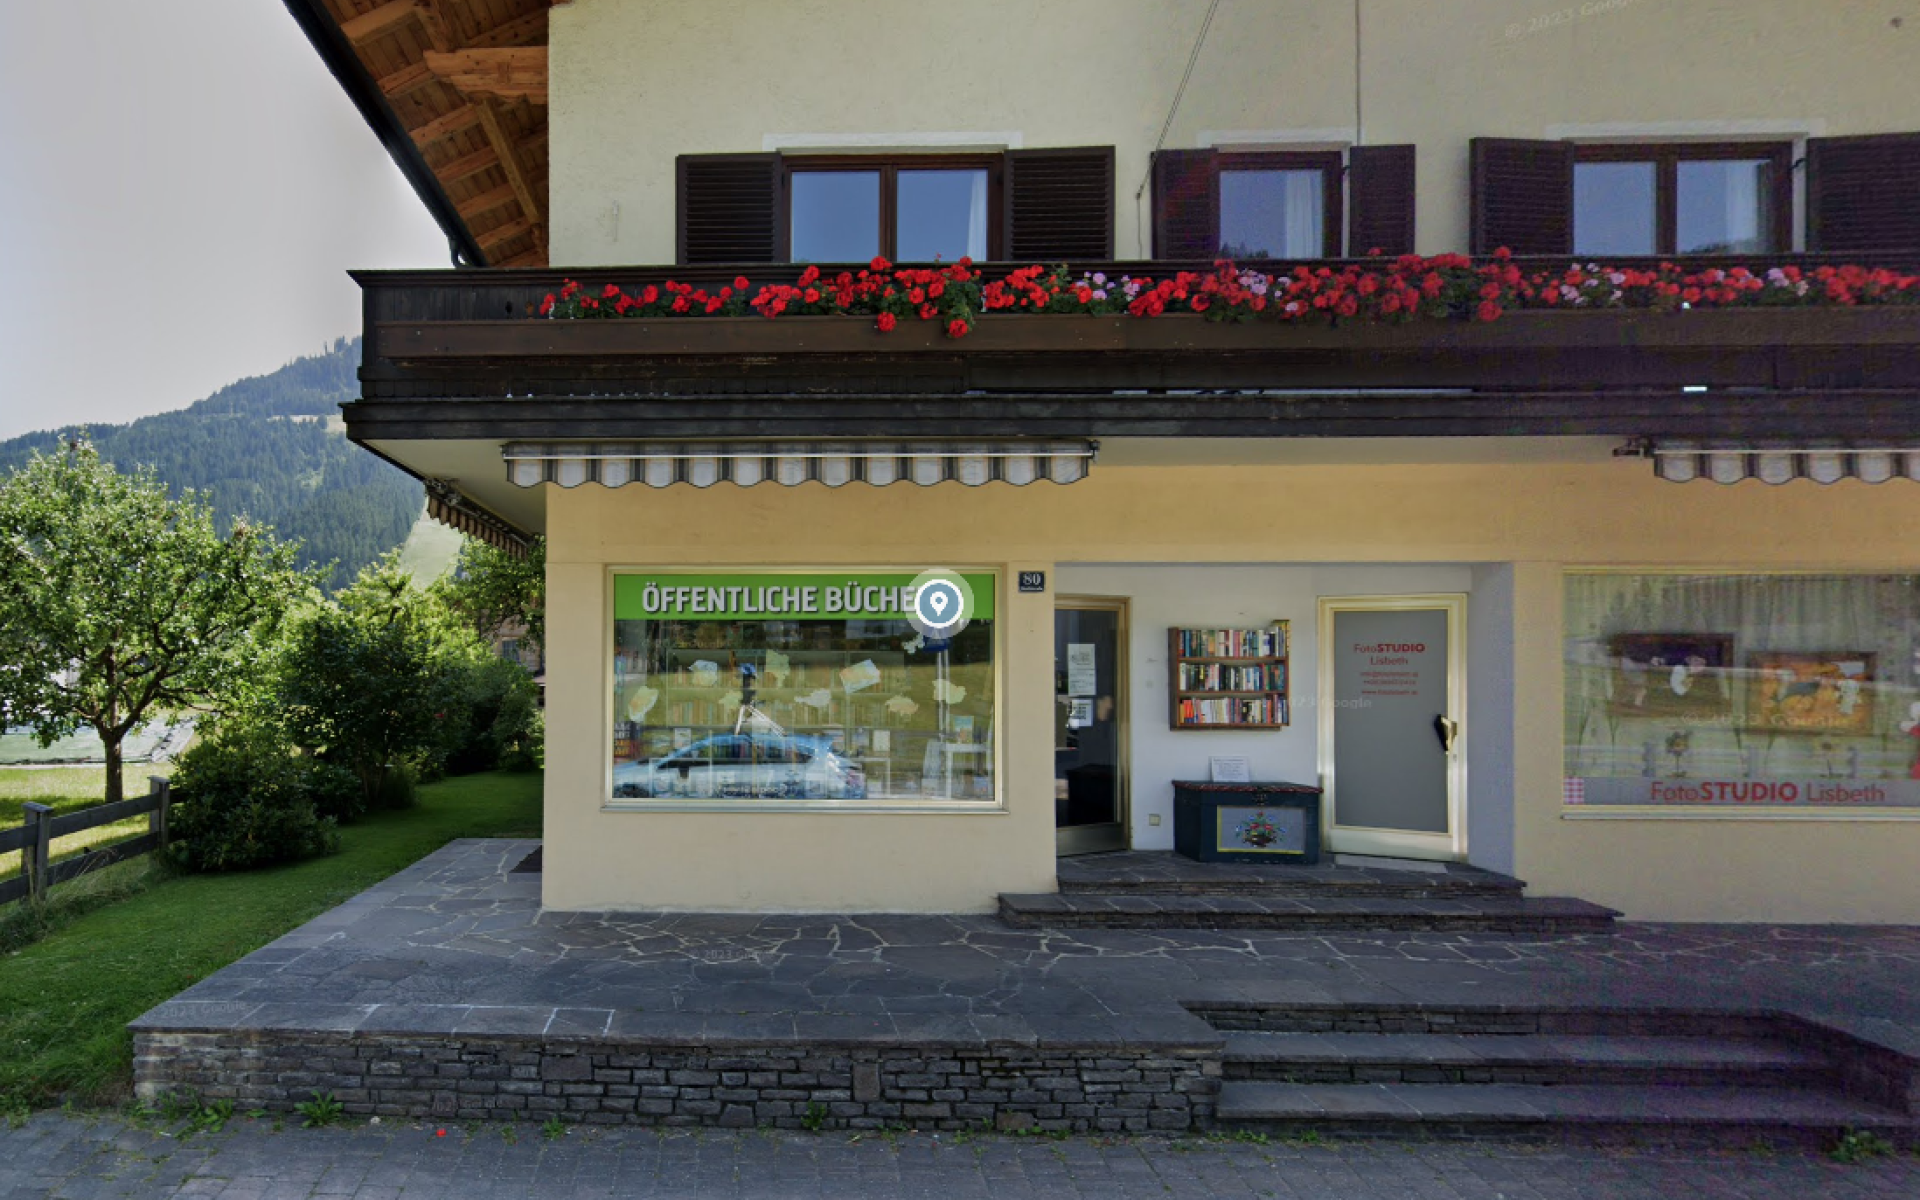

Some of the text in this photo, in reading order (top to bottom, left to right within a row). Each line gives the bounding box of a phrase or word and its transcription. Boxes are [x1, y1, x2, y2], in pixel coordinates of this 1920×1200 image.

[1022, 573, 1041, 585] 80
[642, 581, 918, 612] ÖFFENTLICHE BÜCHE
[1353, 643, 1426, 653] FotoSTUDIO
[1370, 655, 1409, 666] Lisbeth
[1651, 781, 1886, 802] FotoSTUDIO Lisbeth
